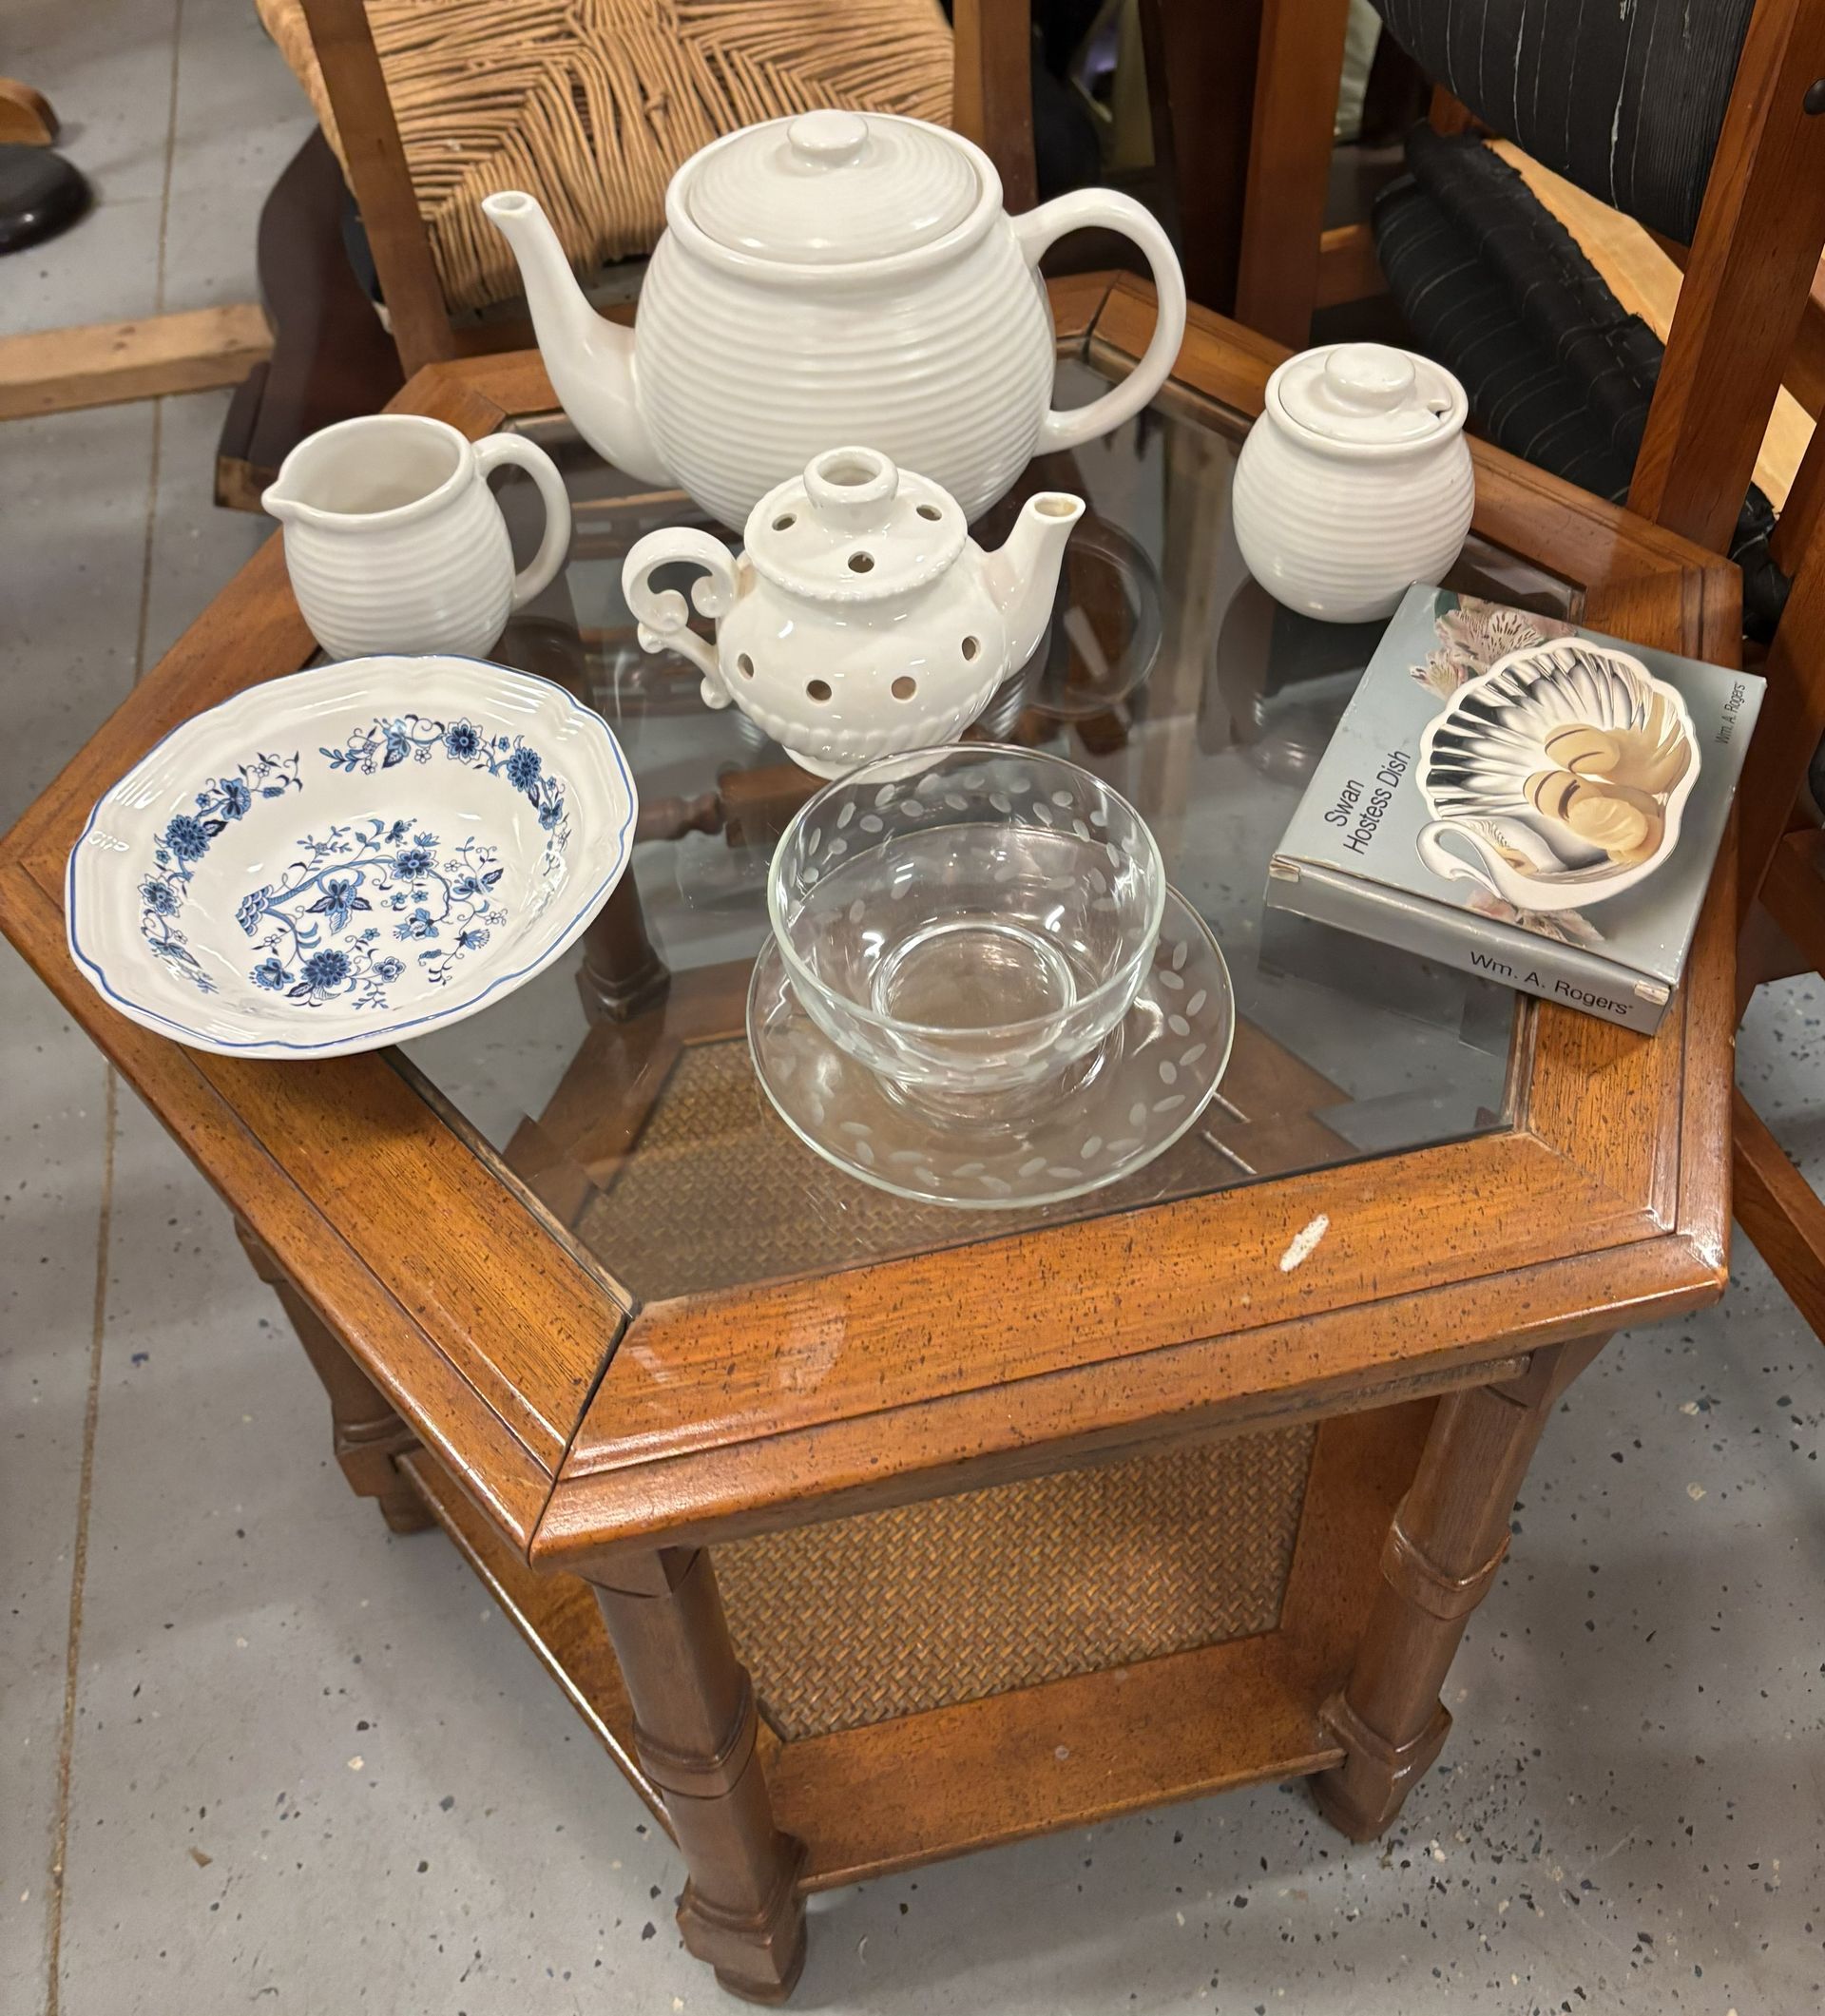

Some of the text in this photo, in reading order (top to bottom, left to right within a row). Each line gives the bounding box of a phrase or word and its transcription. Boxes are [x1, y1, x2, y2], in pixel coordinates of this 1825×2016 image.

[1724, 682, 1746, 713] Rogers
[1324, 779, 1365, 827] Swan
[1343, 750, 1412, 855] Hostess Dish
[1470, 951, 1629, 1015] Wm. A. Rogers
